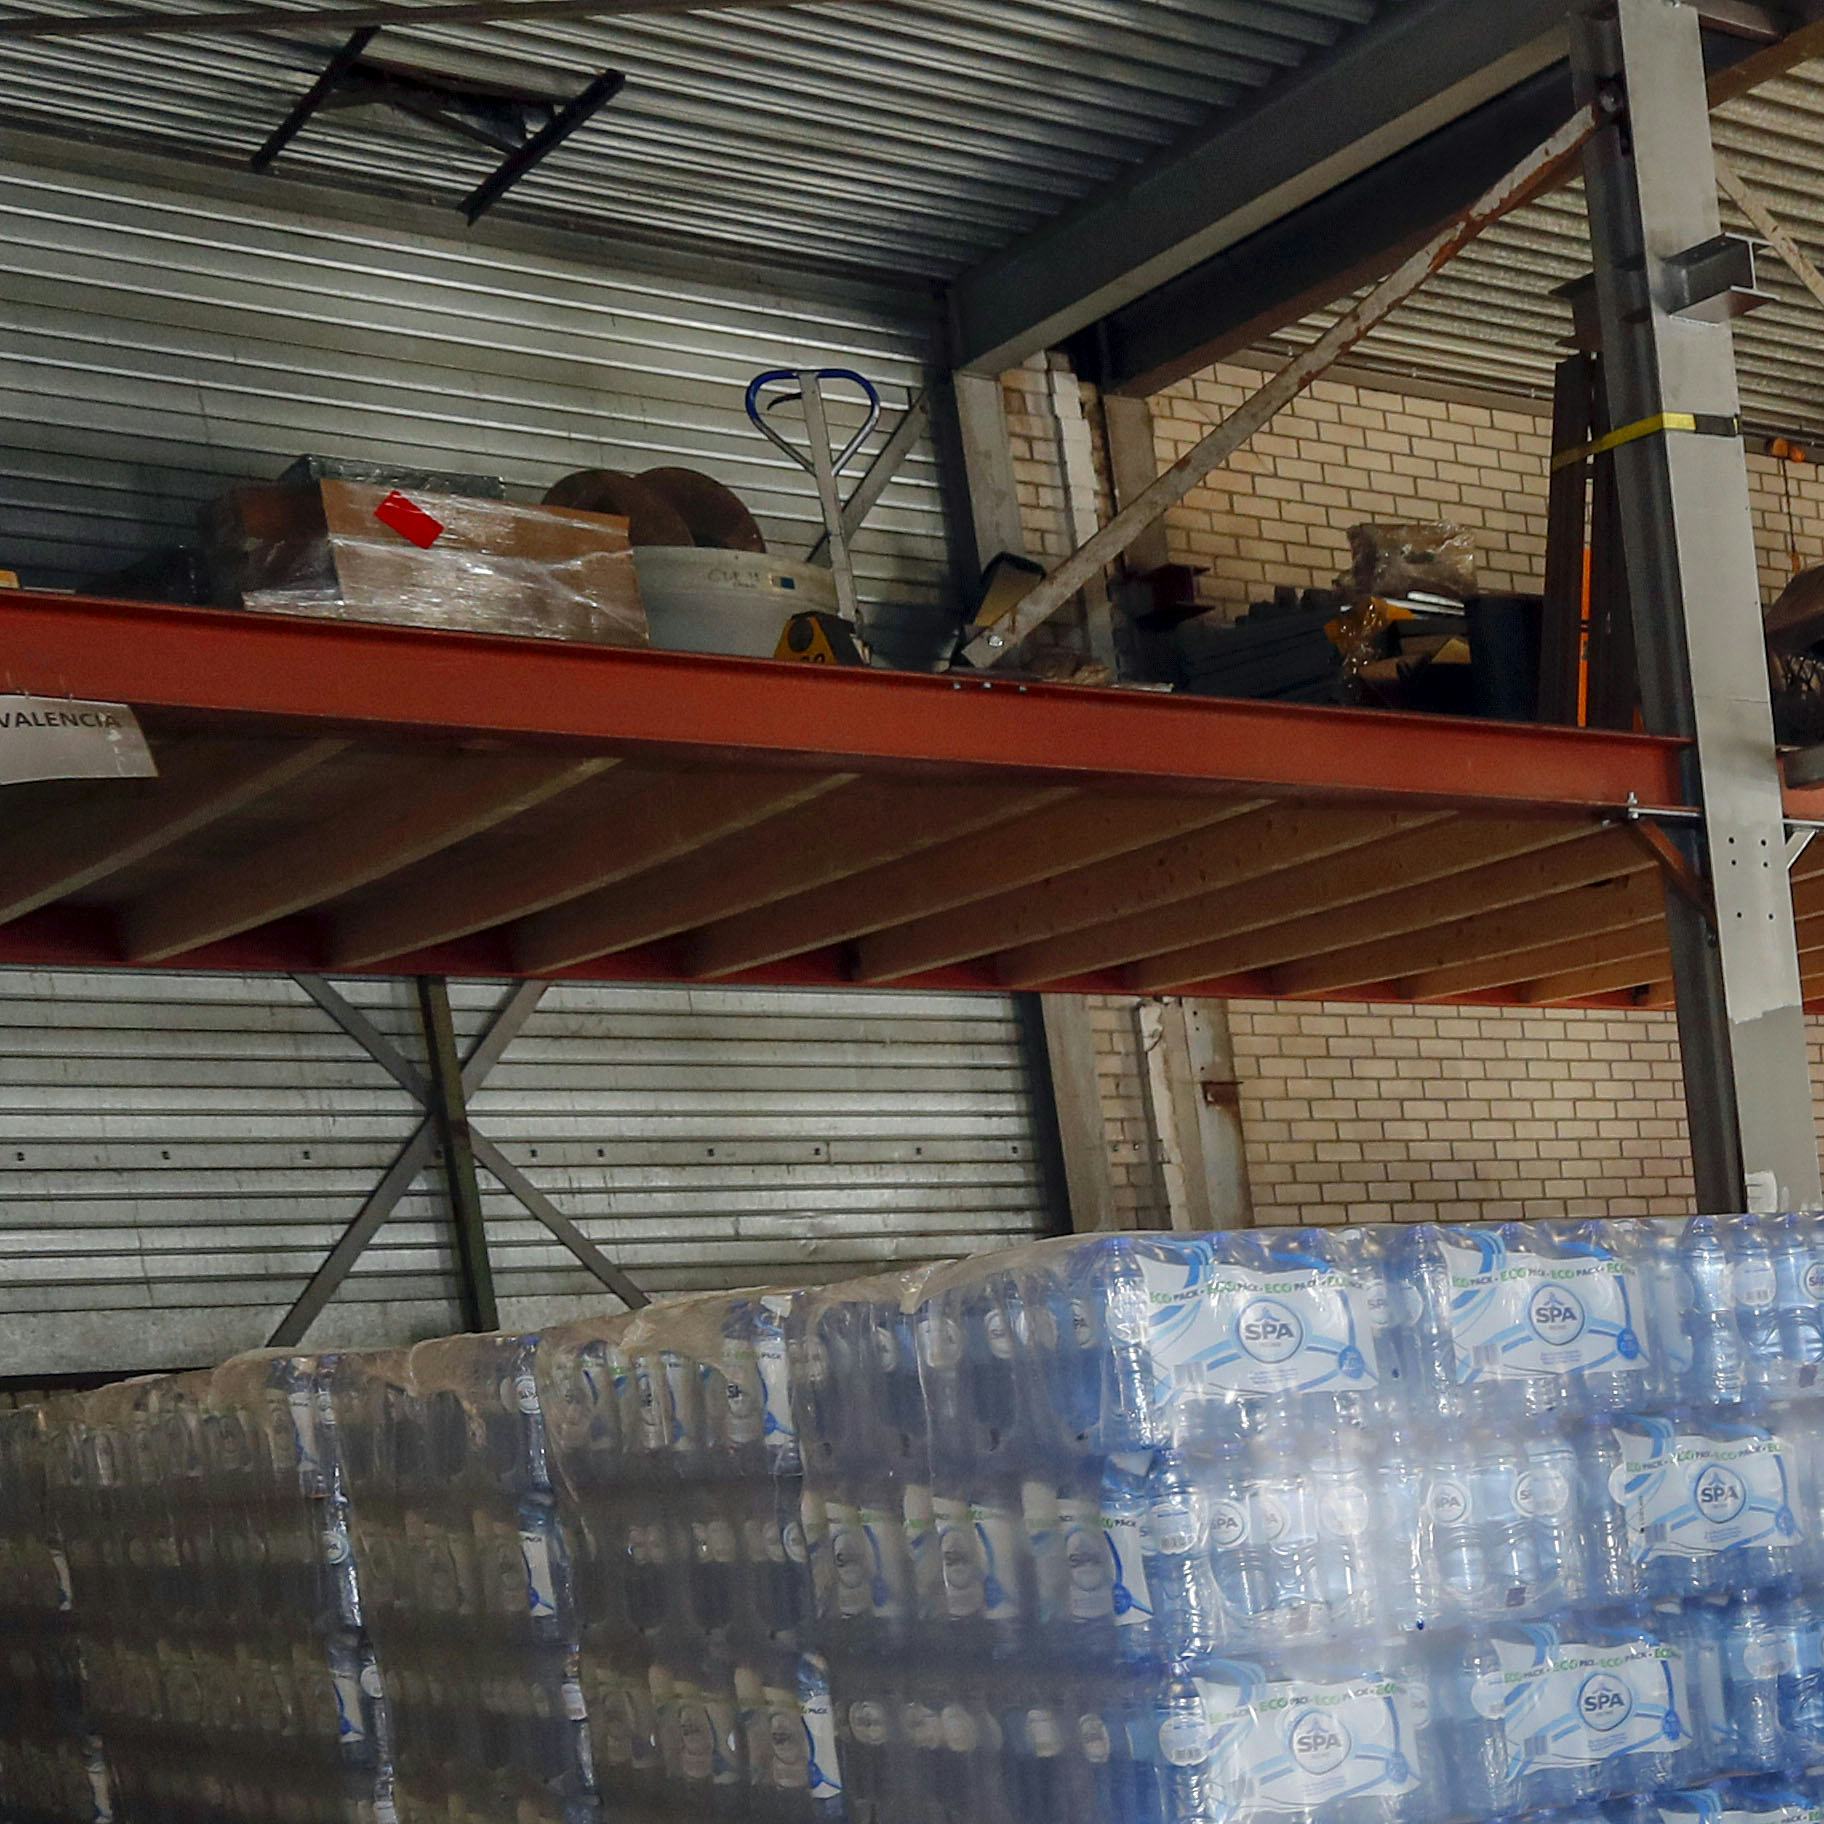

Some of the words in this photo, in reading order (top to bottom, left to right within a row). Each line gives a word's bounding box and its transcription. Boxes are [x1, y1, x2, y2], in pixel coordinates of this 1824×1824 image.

[1536, 1307, 1577, 1324] SPA
[1245, 1322, 1294, 1341] SPA
[1701, 1486, 1739, 1504] SPA
[1584, 1693, 1625, 1712] SPA
[1297, 1733, 1341, 1752] SPA
